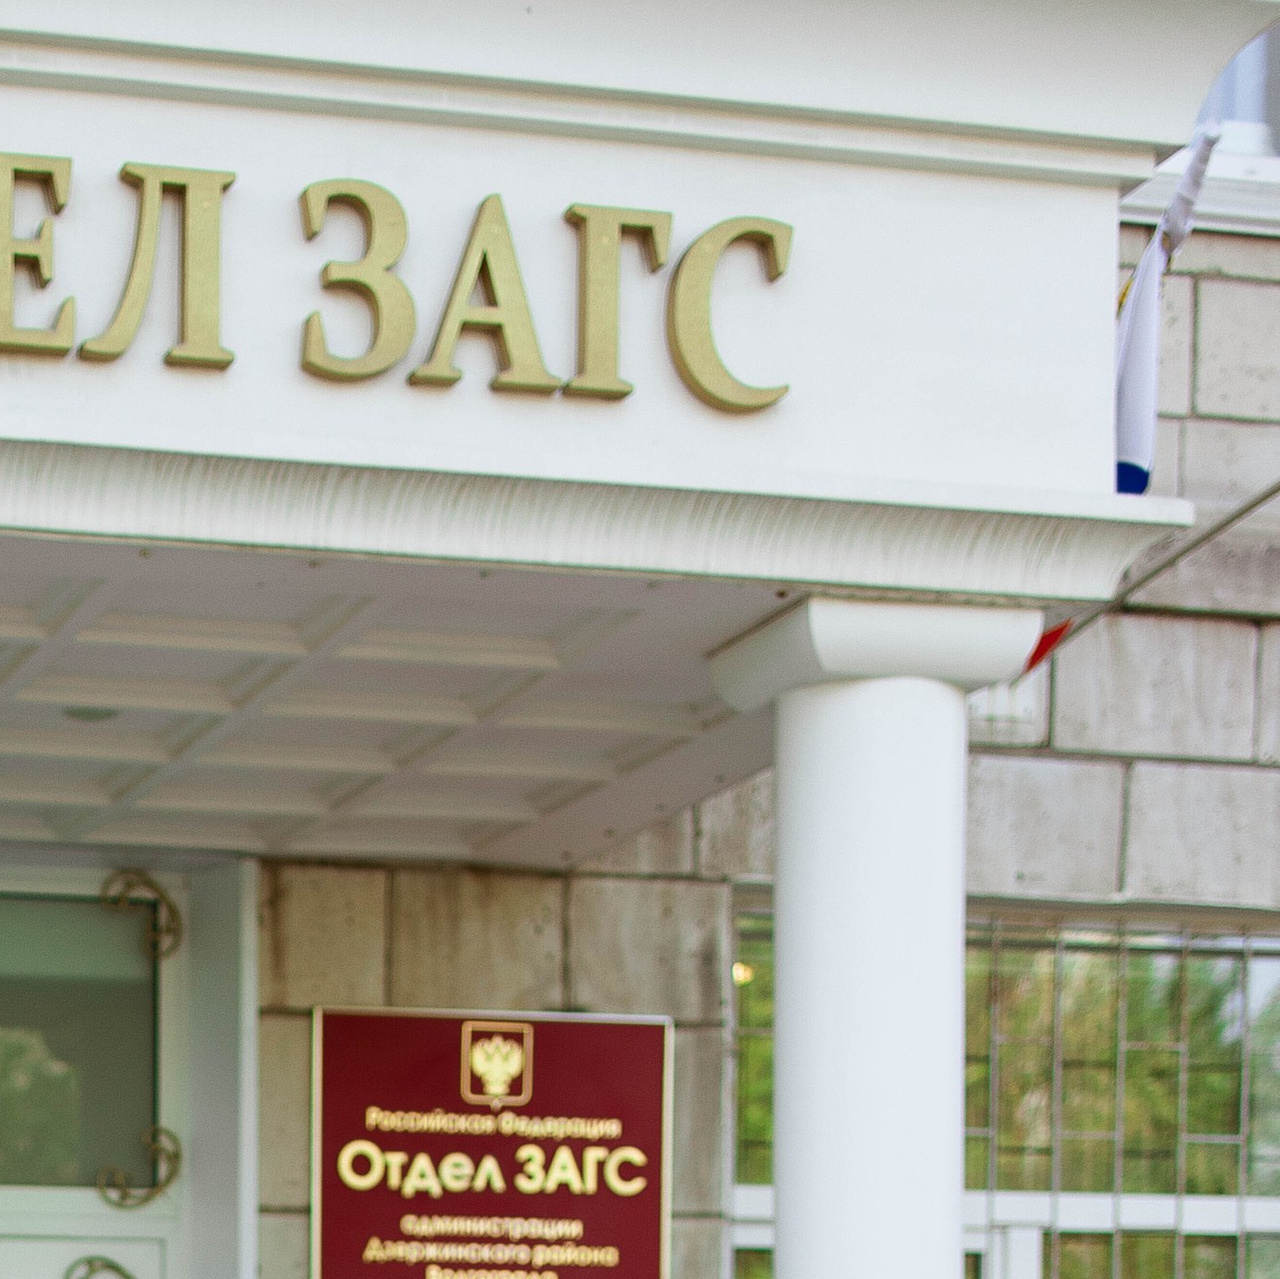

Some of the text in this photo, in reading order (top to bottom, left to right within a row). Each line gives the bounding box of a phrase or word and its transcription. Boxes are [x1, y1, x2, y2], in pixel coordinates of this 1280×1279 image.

[300, 178, 794, 415] ЗАГС
[366, 1106, 622, 1141] Российская Федерация
[337, 1139, 649, 1199] Отдел ЗАГС
[532, 1241, 620, 1268] района
